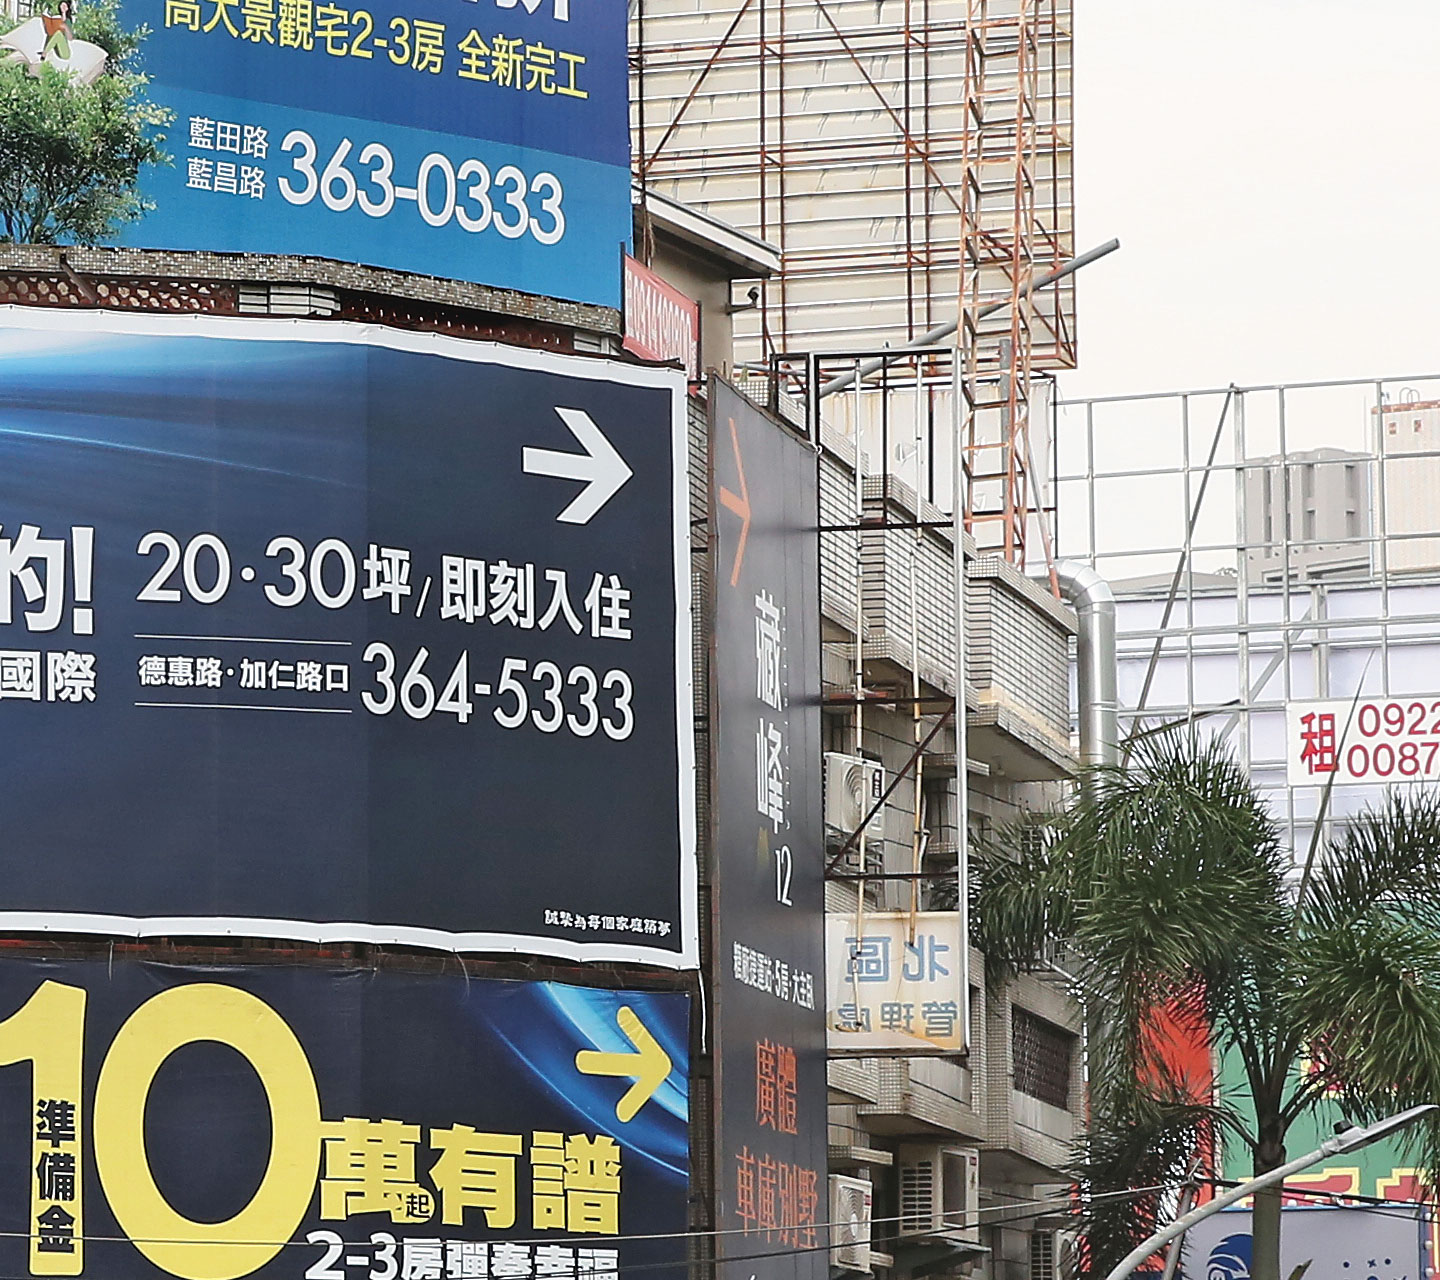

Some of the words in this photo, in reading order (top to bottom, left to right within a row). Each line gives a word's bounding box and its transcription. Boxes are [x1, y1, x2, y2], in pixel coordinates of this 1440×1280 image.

[457, 26, 590, 101] 全新完工
[186, 154, 267, 200] 藍昌路
[187, 114, 269, 160] 藍田路
[278, 126, 568, 246] 363-0333
[361, 641, 634, 743] 364-5333
[1299, 712, 1336, 775] 租
[774, 844, 794, 908] 12
[33, 1100, 77, 1257] 準備金
[734, 1145, 818, 1251] 車庫別墅
